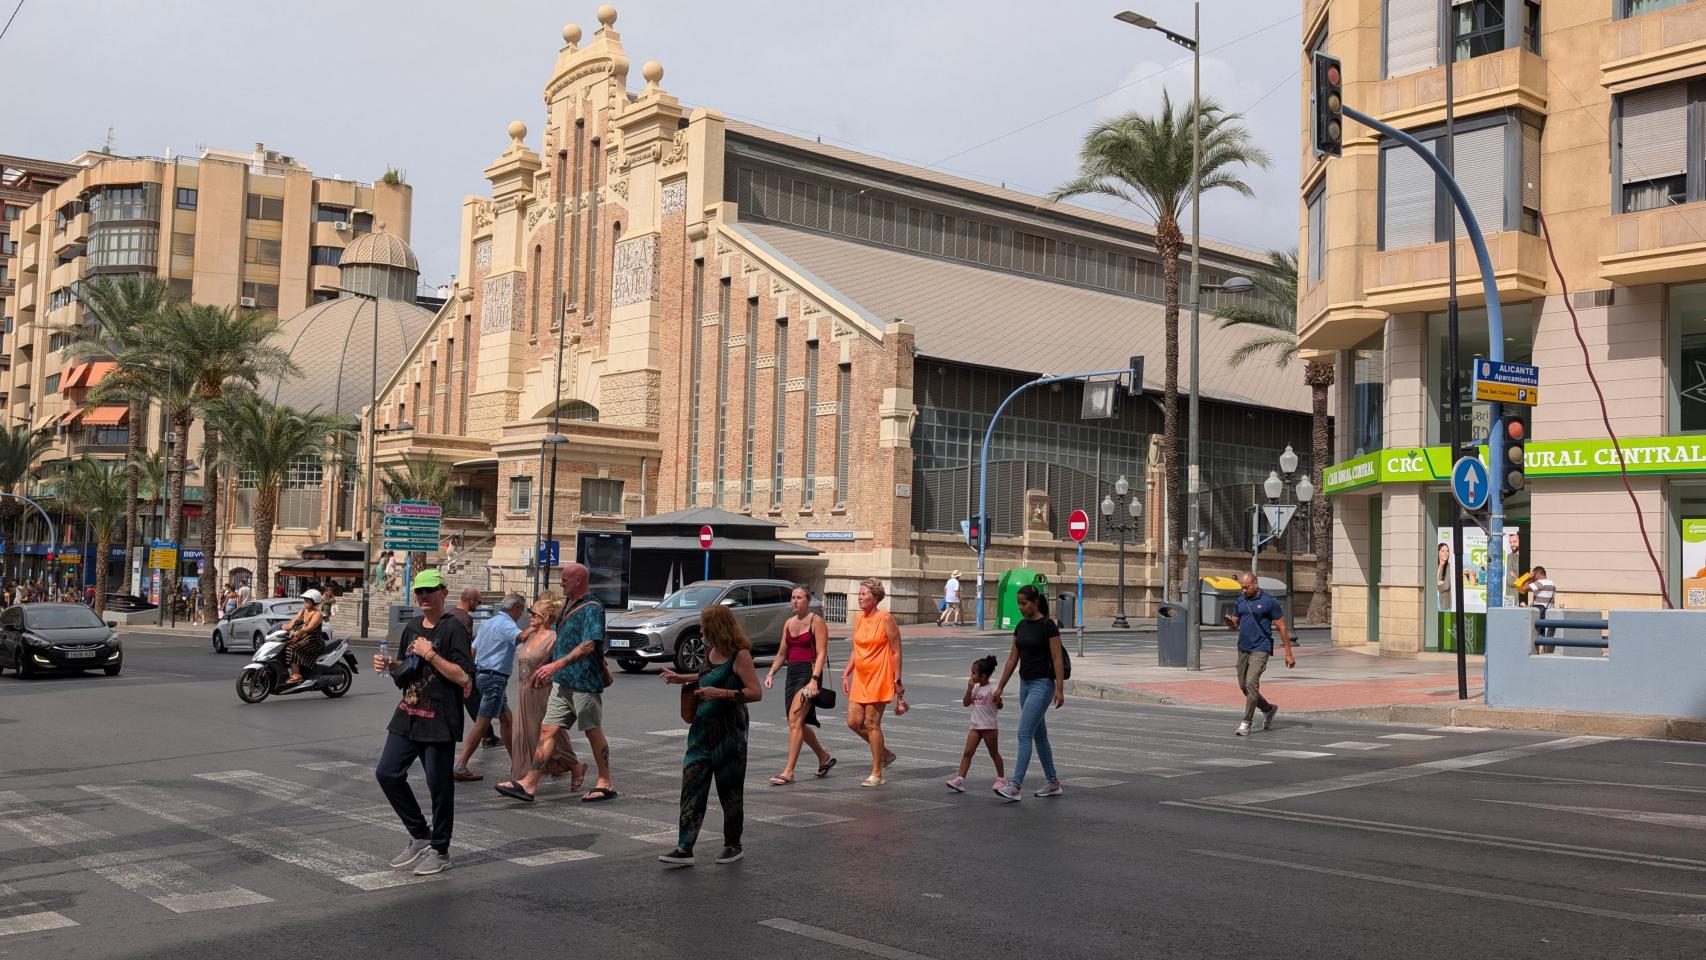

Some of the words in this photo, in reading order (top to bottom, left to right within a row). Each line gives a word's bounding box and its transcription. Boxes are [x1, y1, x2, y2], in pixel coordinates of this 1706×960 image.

[1499, 364, 1534, 376] ALICANTE
[1494, 373, 1537, 385] Aparcamientos
[1594, 445, 1706, 465] CENTRAL
[1352, 461, 1375, 479] CENTRAL
[1387, 457, 1424, 473] CRC
